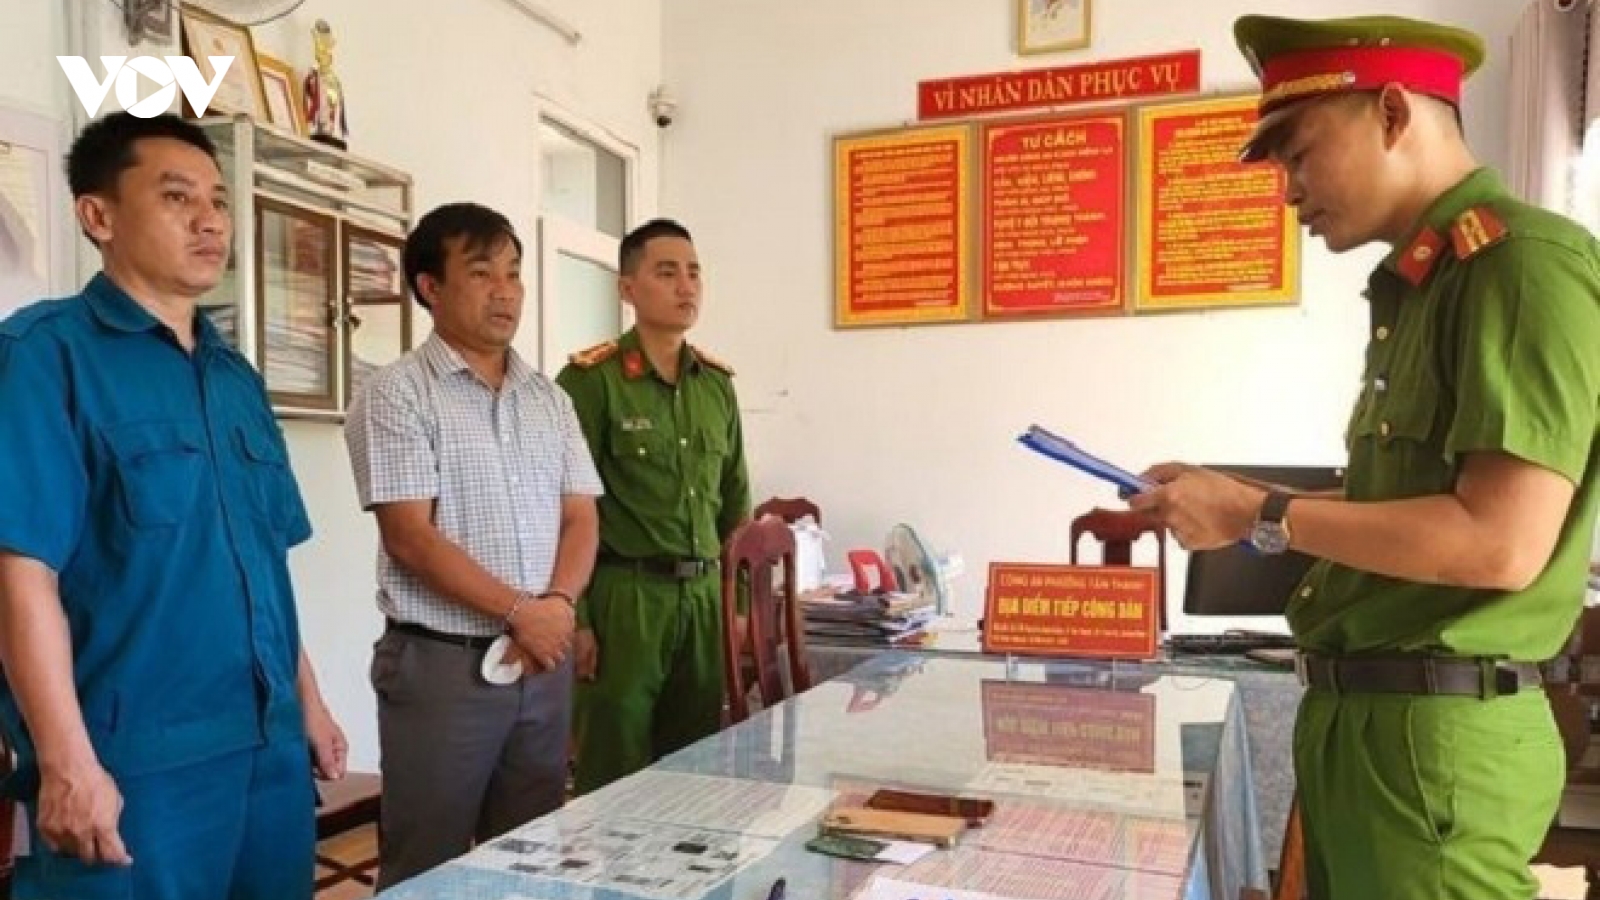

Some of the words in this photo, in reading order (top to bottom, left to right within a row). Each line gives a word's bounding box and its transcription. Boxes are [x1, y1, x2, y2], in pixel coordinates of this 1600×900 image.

[933, 82, 954, 111] VÌ
[959, 76, 1023, 109] NHÂN
[1027, 71, 1074, 103] DÂN
[1079, 66, 1143, 98] PHỤC
[1150, 61, 1182, 92] VỤ
